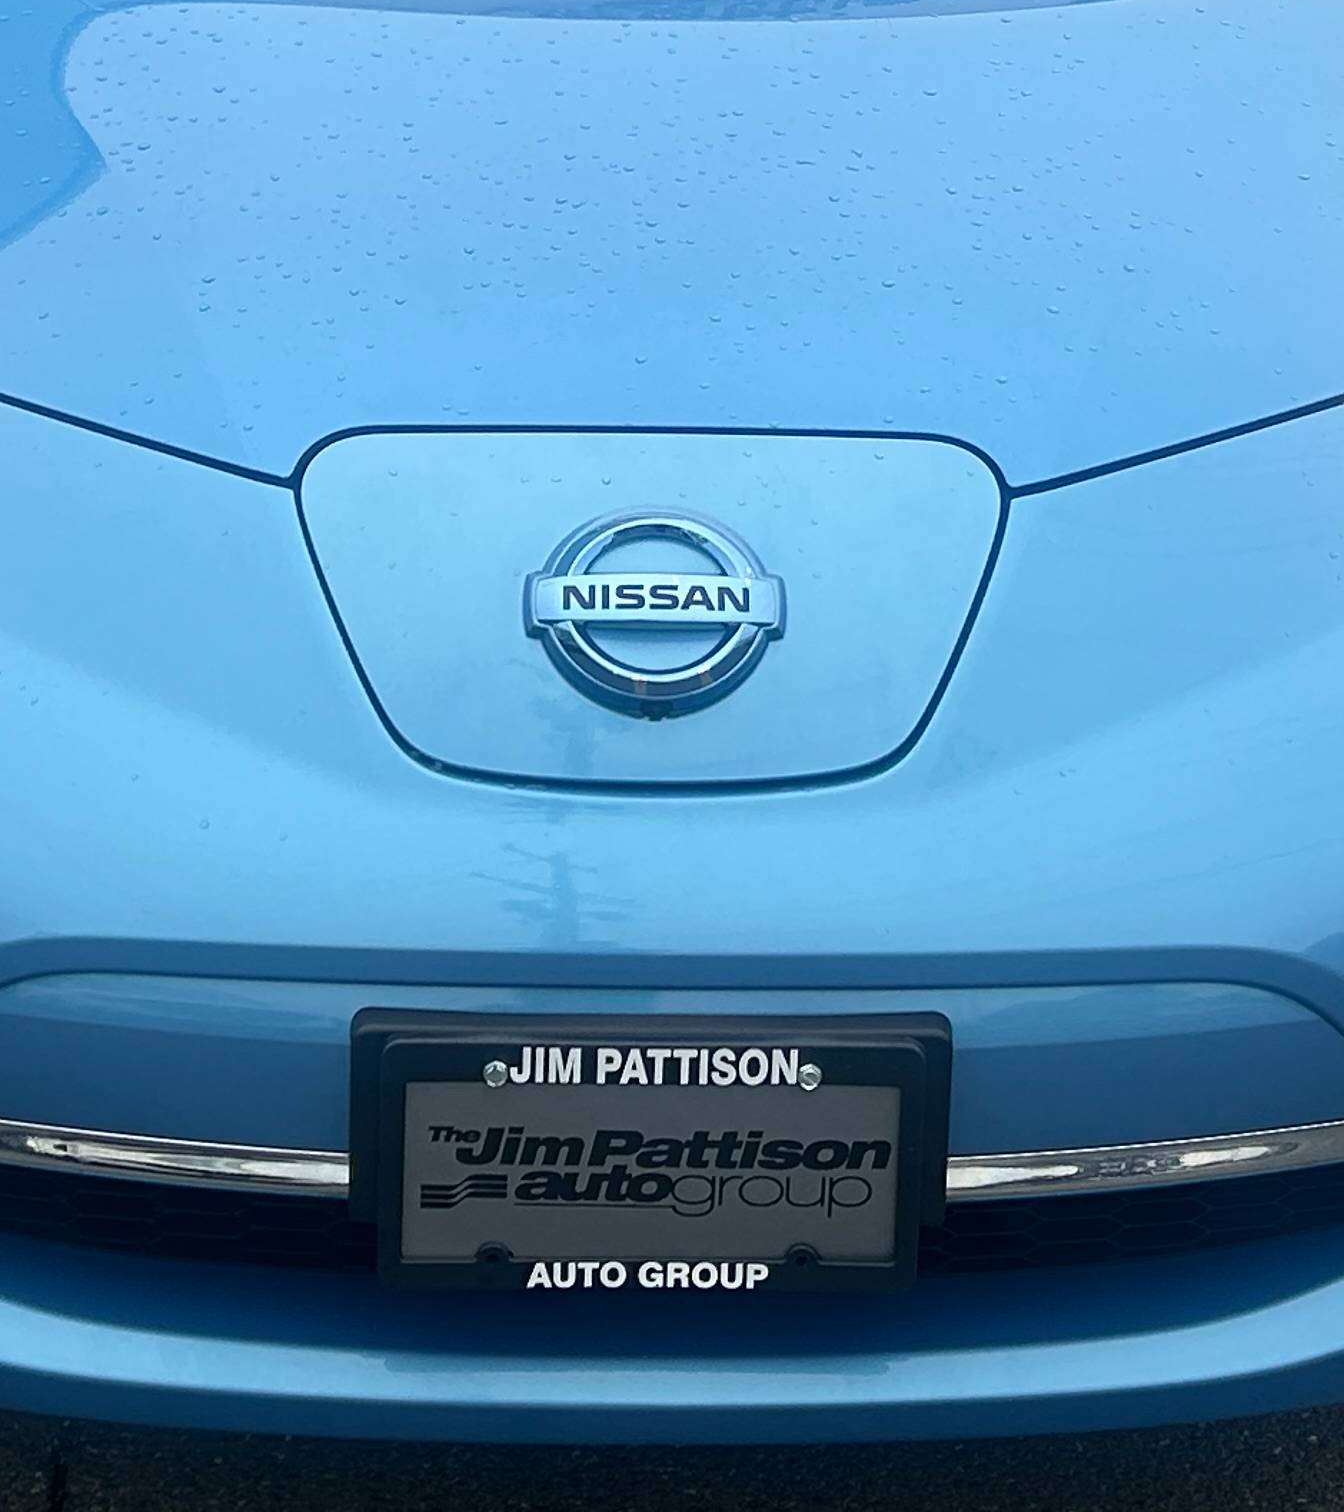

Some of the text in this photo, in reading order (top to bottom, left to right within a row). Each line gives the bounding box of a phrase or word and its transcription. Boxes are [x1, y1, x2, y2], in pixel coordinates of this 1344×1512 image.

[562, 584, 750, 613] NISSAN
[509, 1046, 799, 1086] JIM PATTISON
[526, 1261, 770, 1289] AUTO GROUP
